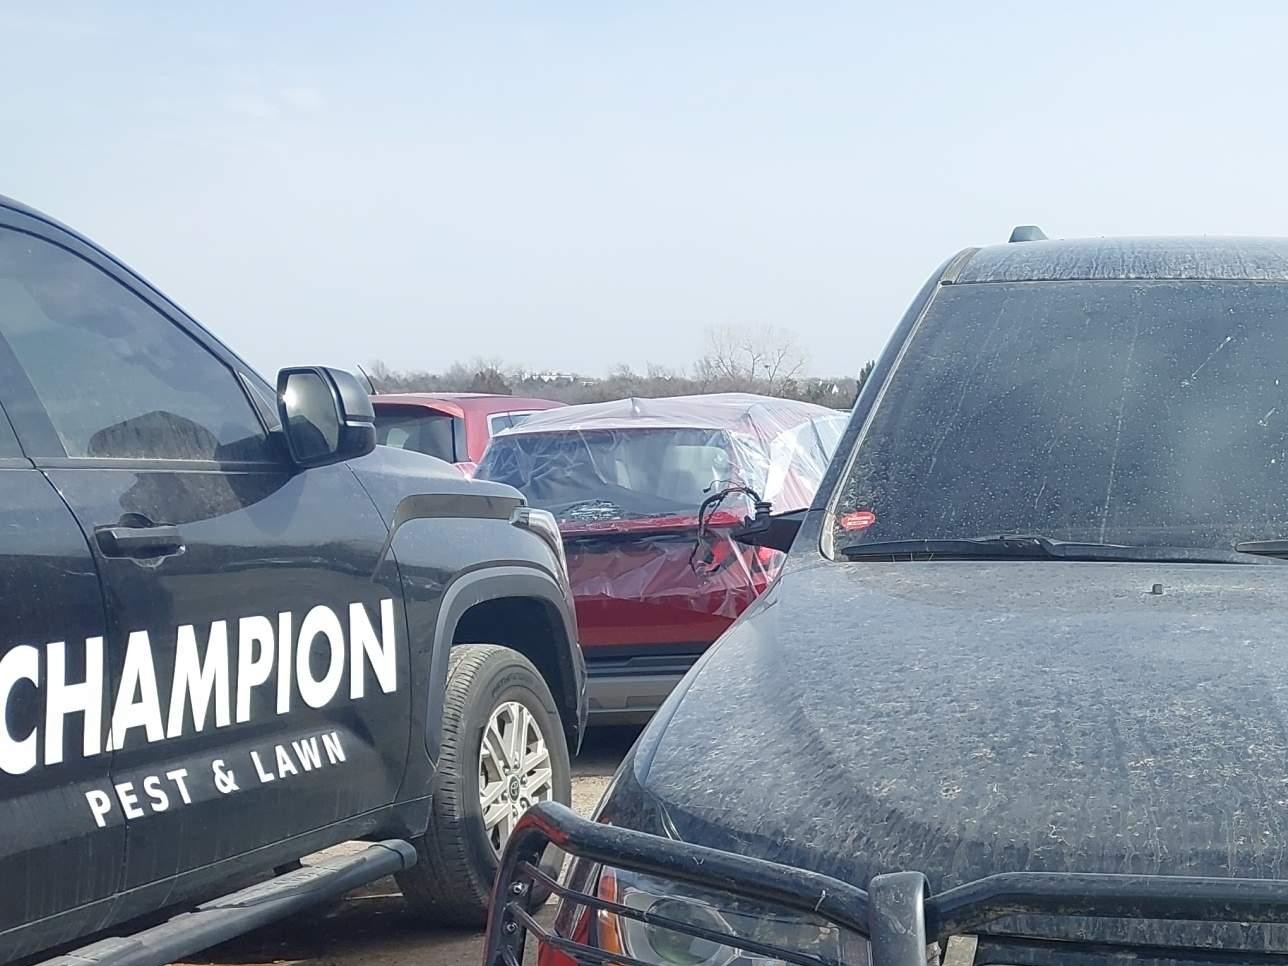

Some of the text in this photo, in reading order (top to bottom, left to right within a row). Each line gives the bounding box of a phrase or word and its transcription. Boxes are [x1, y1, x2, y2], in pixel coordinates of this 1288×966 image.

[0, 599, 397, 775] CHAMPION
[85, 731, 346, 828] PEST & LAWN
